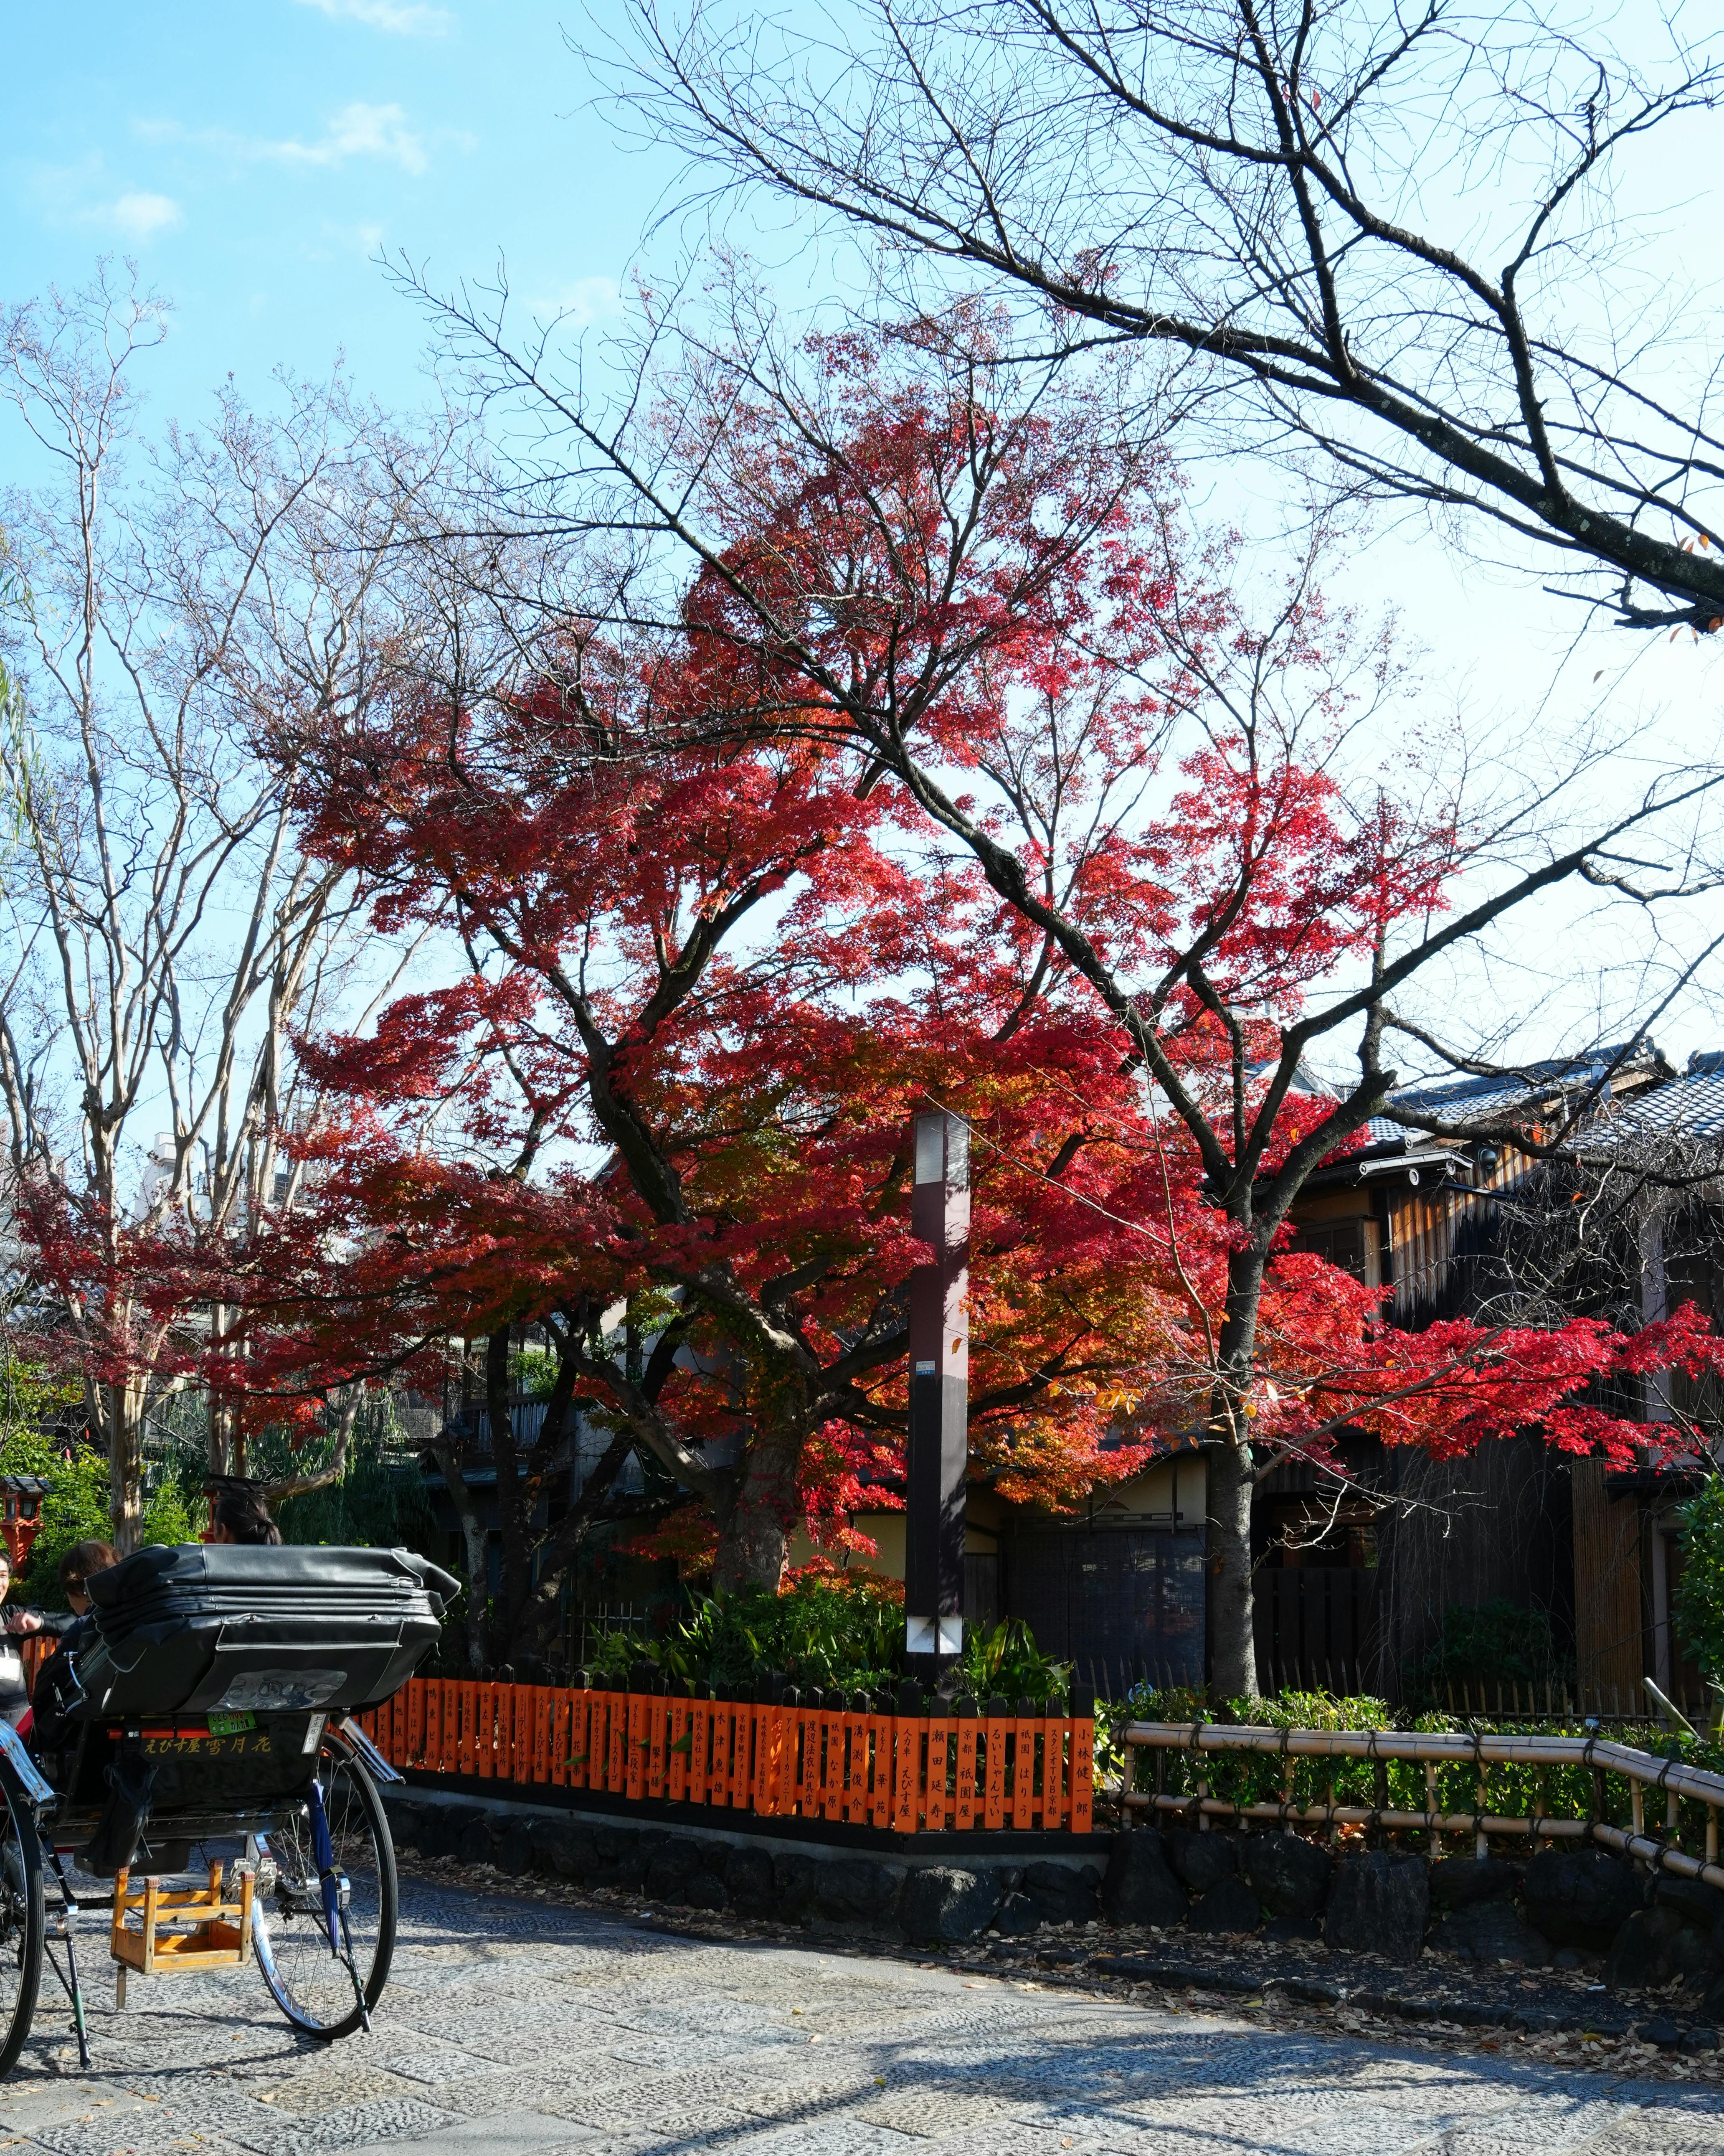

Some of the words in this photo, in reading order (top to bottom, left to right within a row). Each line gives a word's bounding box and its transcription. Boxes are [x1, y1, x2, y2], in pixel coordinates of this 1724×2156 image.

[231, 1718, 250, 1730] の人力車
[428, 1688, 437, 1759] 鴨東ビル
[446, 1732, 453, 1761] 中谷
[831, 1722, 839, 1747] 祇園
[903, 1728, 913, 1757] 人力車
[962, 1729, 972, 1755] 京都
[1020, 1729, 1031, 1755] 祇園
[464, 1752, 471, 1762] 弘
[535, 1728, 545, 1772] えびす屋
[554, 1730, 563, 1775] えびす屋
[630, 1735, 639, 1784] 十二段家
[737, 1714, 746, 1797] 京都景観フォーラム
[805, 1720, 816, 1806] 渡辺法衣仏具店
[930, 1729, 945, 1818] 瀬田延寿
[989, 1729, 1002, 1817] るいしゃんてい
[1047, 1729, 1058, 1816] スタジオTVB京都
[1076, 1728, 1090, 1816] 小林健一郎
[827, 1760, 838, 1808] なか原
[876, 1773, 888, 1814] 華苑
[898, 1767, 914, 1818] えびす屋
[958, 1767, 973, 1818] 祇園屋
[1019, 1768, 1030, 1817] はりう
